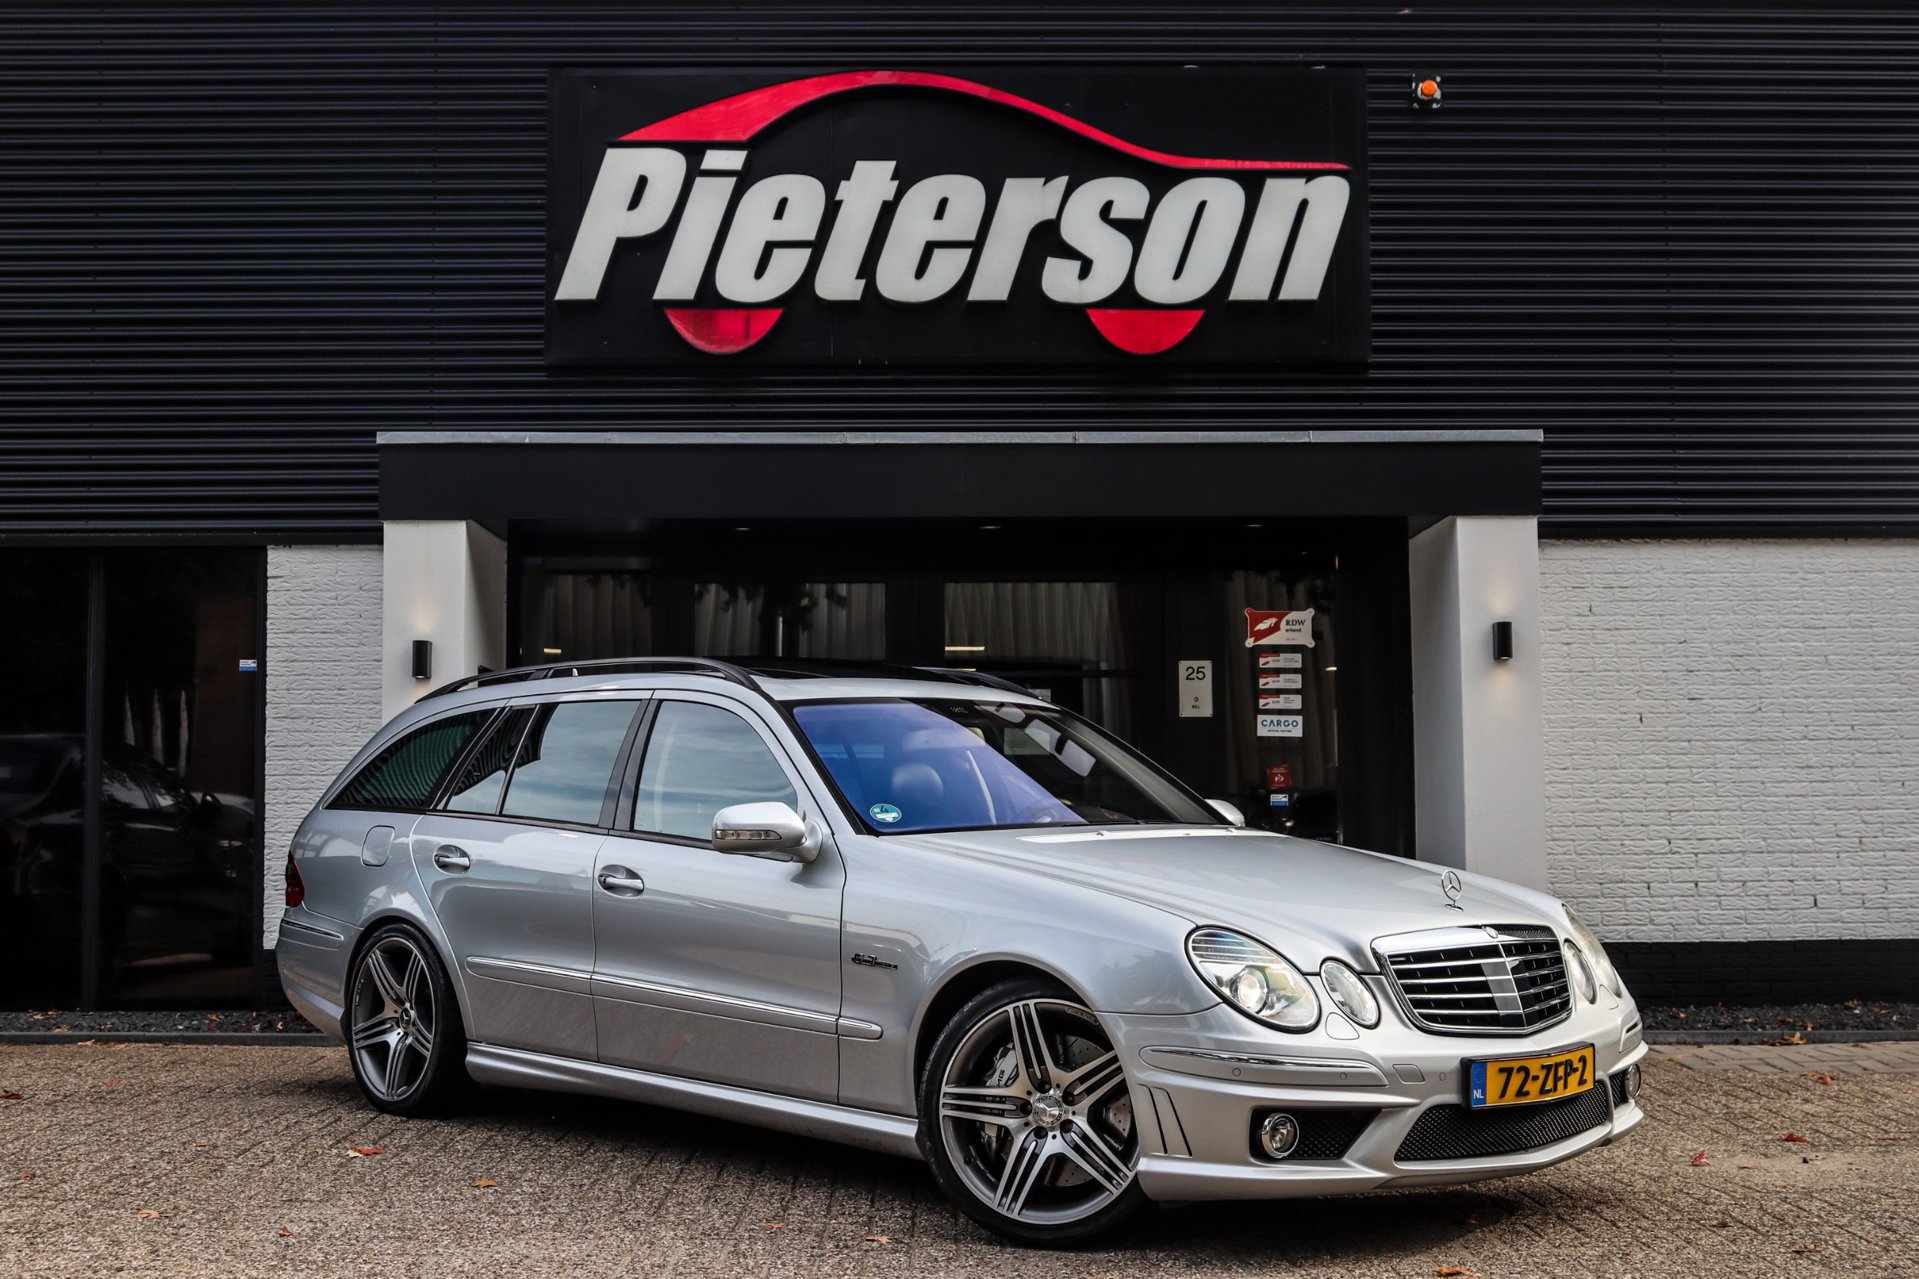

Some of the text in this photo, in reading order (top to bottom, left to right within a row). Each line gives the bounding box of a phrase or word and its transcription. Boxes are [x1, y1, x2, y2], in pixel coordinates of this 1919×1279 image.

[554, 147, 1350, 303] Pieterson
[1185, 666, 1206, 680] 25
[1261, 719, 1299, 728] CARGO
[1498, 1054, 1588, 1099] 72-ZFP-2
[1473, 1089, 1485, 1099] NL
